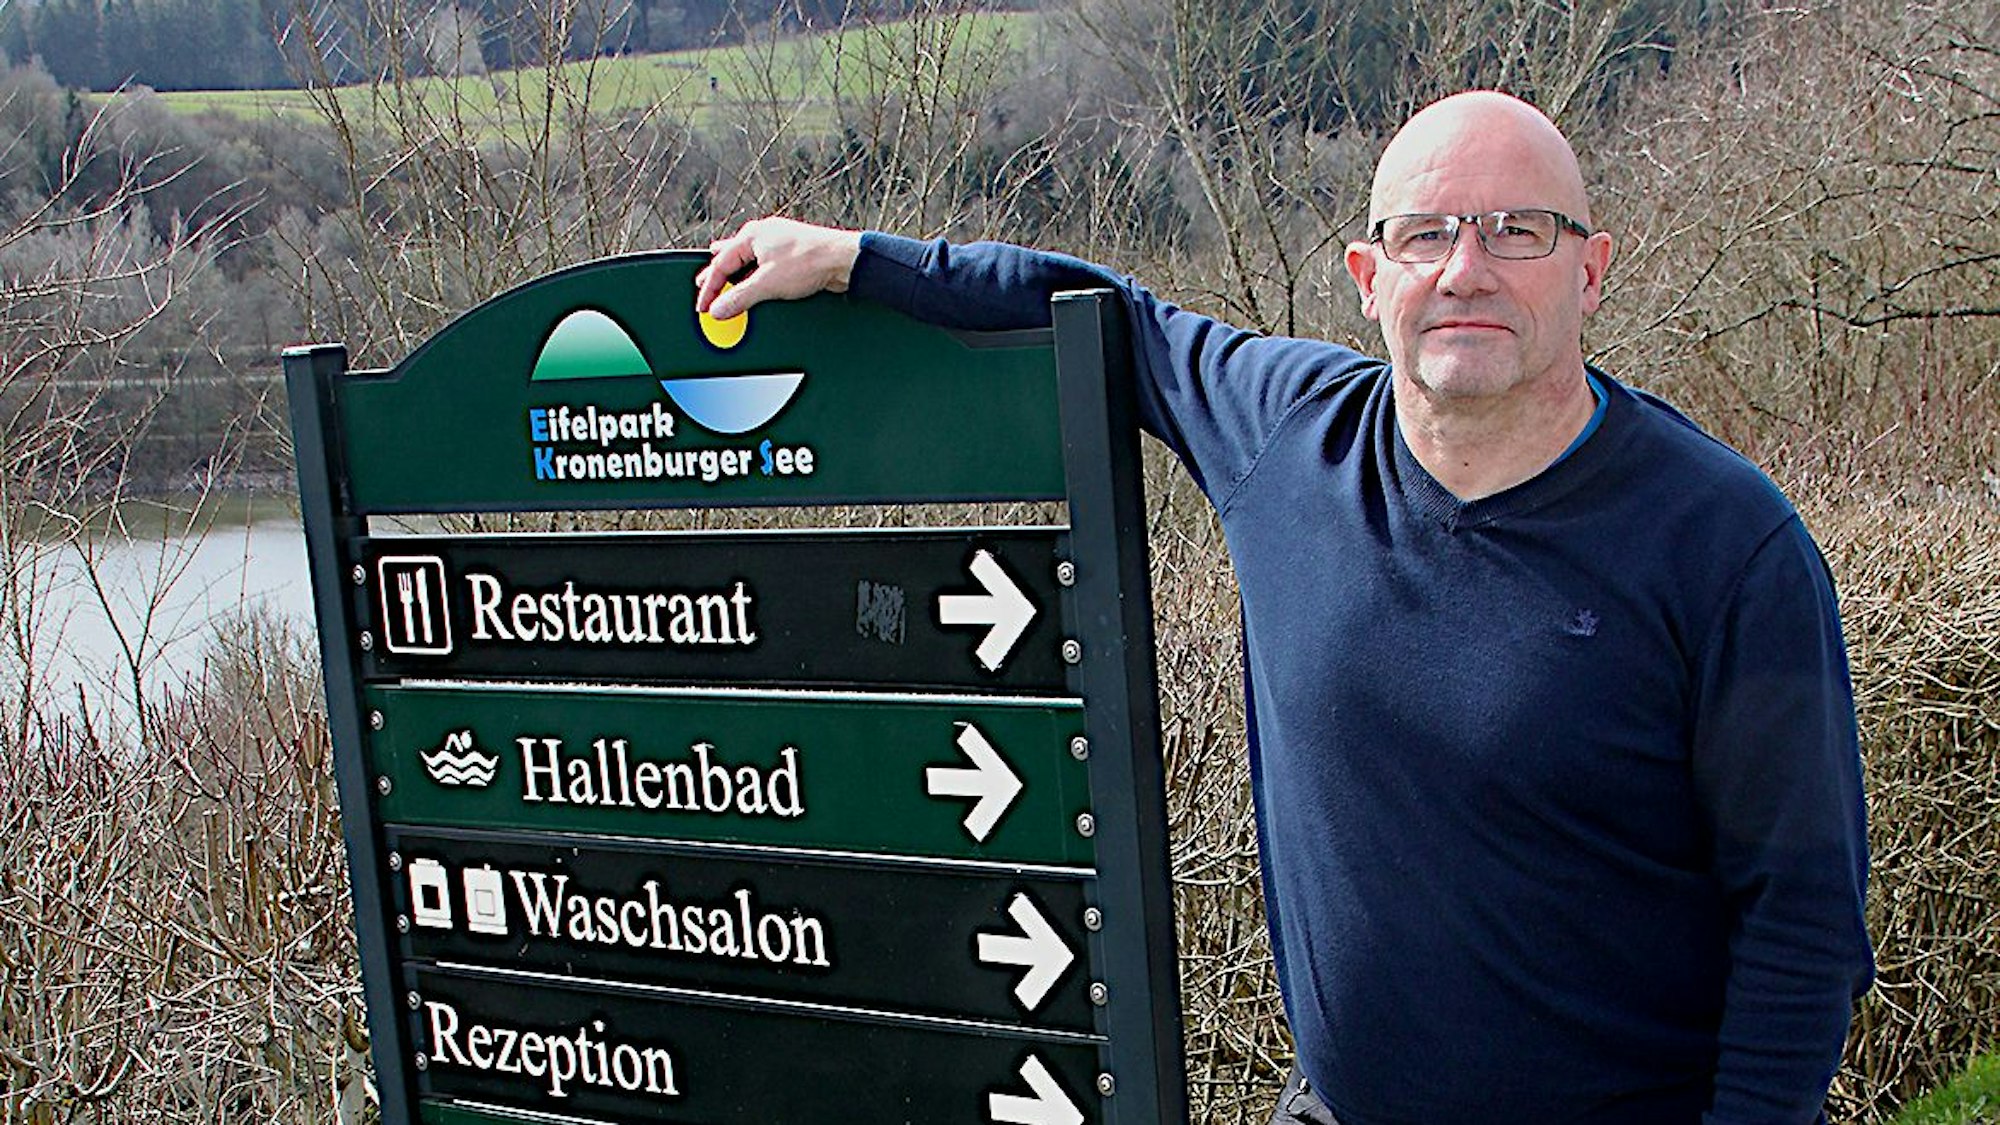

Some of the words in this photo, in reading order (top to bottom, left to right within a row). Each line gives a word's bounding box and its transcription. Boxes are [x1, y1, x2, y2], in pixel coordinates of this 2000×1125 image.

[529, 402, 675, 446] Eifelpark
[533, 442, 752, 482] Kronenburger
[759, 438, 814, 477] See
[465, 573, 757, 645] Restaurant
[516, 736, 805, 817] Hallenbad
[508, 870, 830, 968] Waschsalon
[424, 1000, 680, 1098] Rezeption
